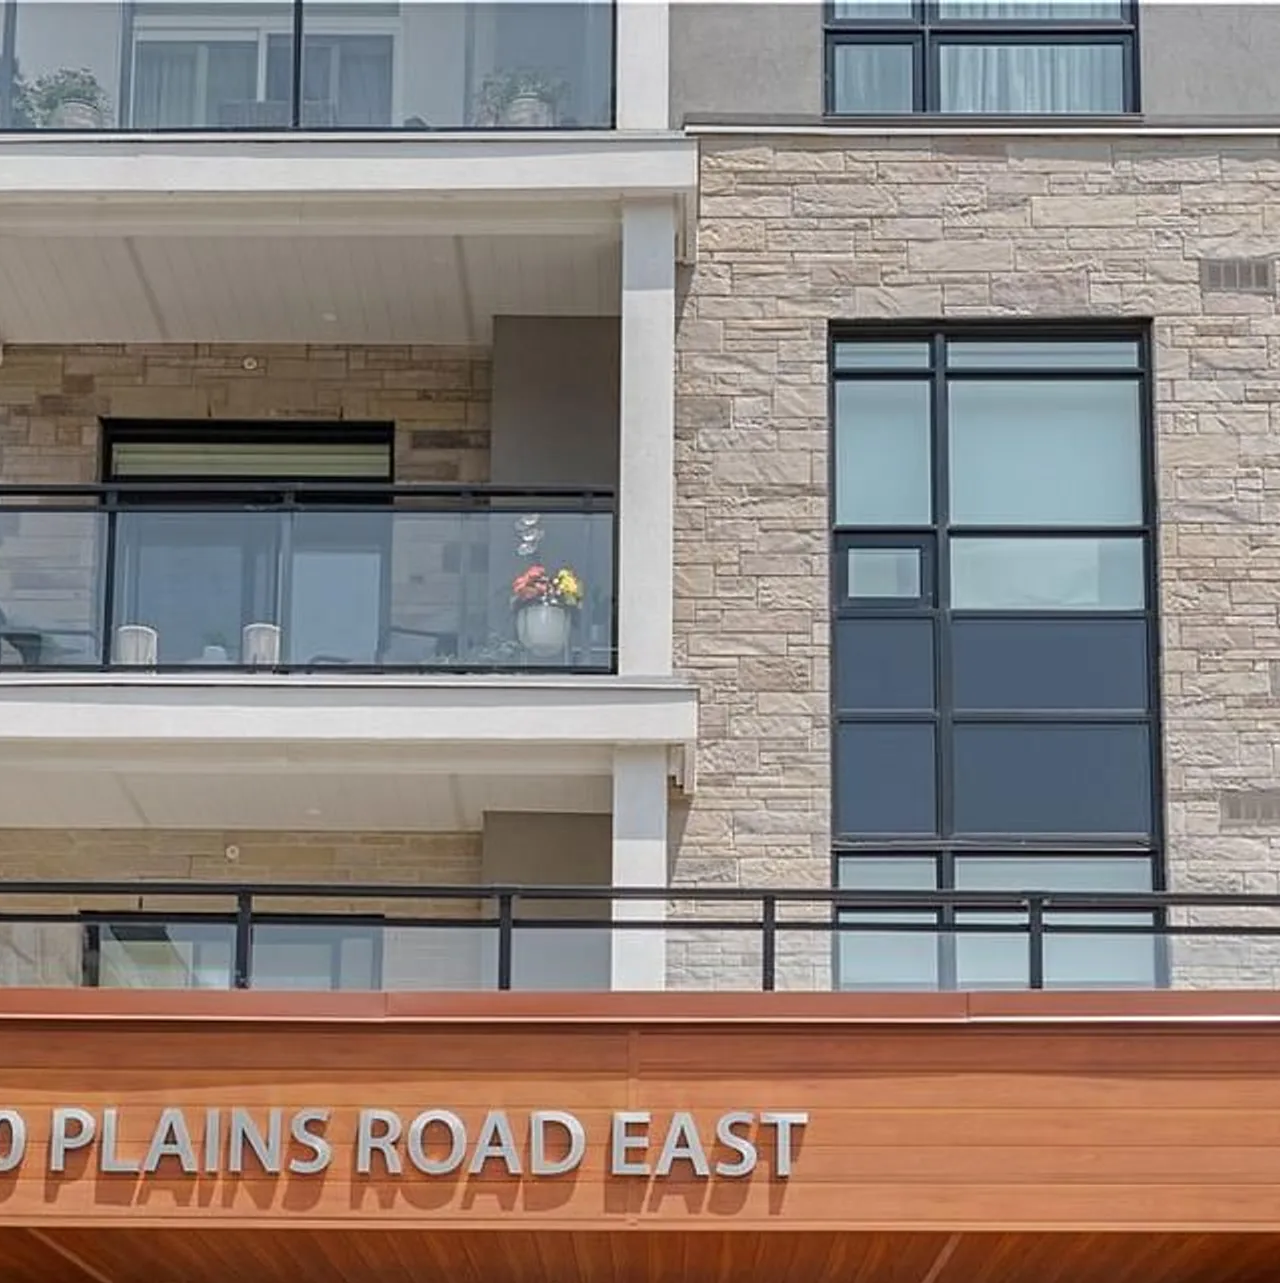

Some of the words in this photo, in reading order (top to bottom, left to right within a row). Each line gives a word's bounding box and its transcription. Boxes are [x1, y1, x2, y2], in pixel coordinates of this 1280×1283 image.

[50, 1107, 335, 1175] PLAINS
[356, 1108, 586, 1176] ROAD
[611, 1110, 809, 1178] EAST
